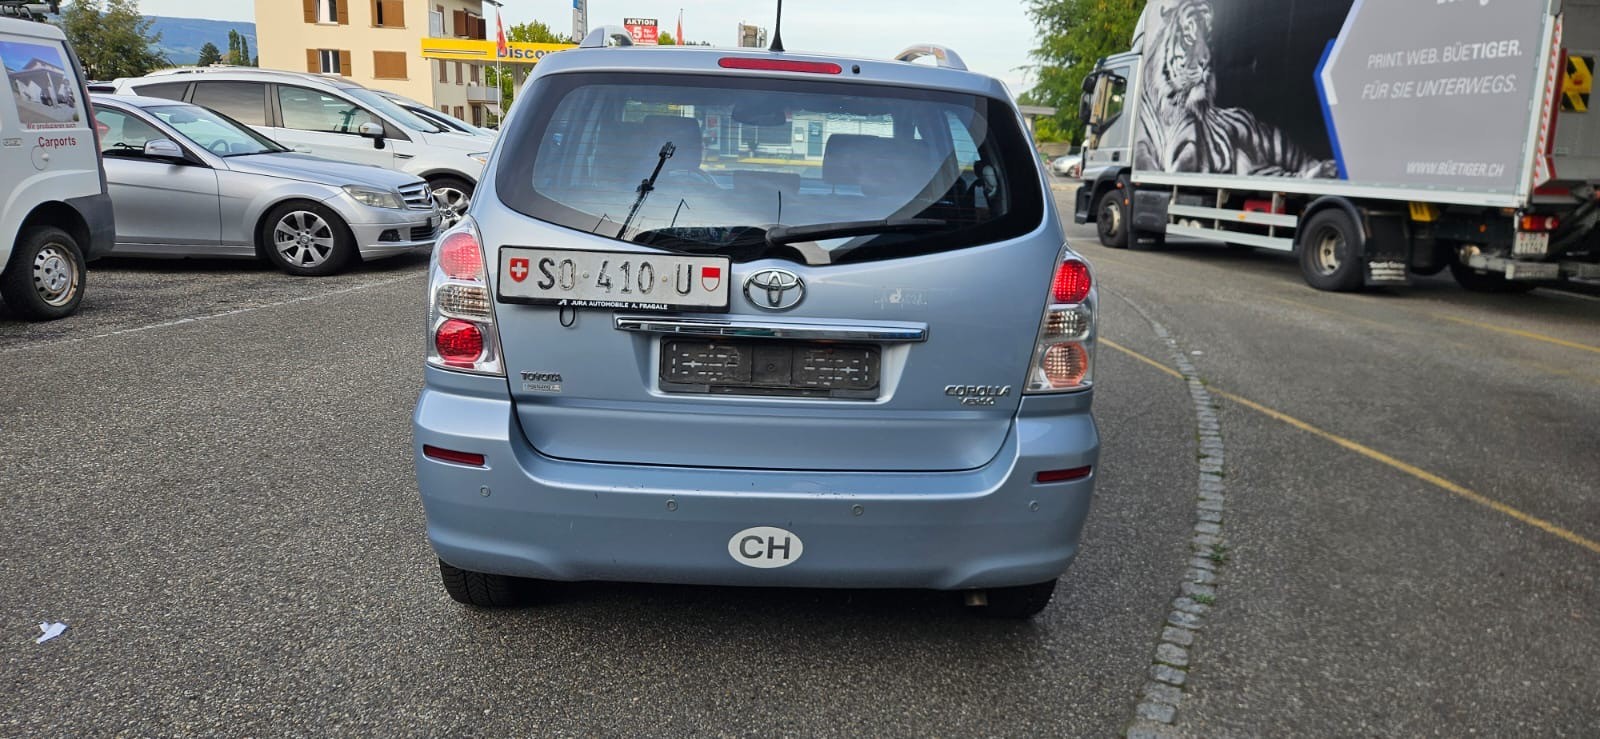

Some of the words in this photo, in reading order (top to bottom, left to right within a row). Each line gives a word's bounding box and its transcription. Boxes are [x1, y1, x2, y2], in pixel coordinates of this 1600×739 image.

[633, 26, 643, 39] 5
[1406, 47, 1440, 65] WEB.
[1442, 39, 1523, 63] BÜETIGER.
[1361, 80, 1389, 100] FÜR
[1390, 81, 1415, 99] SIE
[1415, 74, 1517, 98] UNTERWEGS.
[38, 136, 77, 149] Carports
[537, 257, 576, 291] SO
[595, 260, 655, 296] 410
[675, 263, 693, 296] U
[520, 371, 562, 382] TOYOTA
[944, 385, 1011, 397] COROLLA
[739, 535, 791, 560] CH
